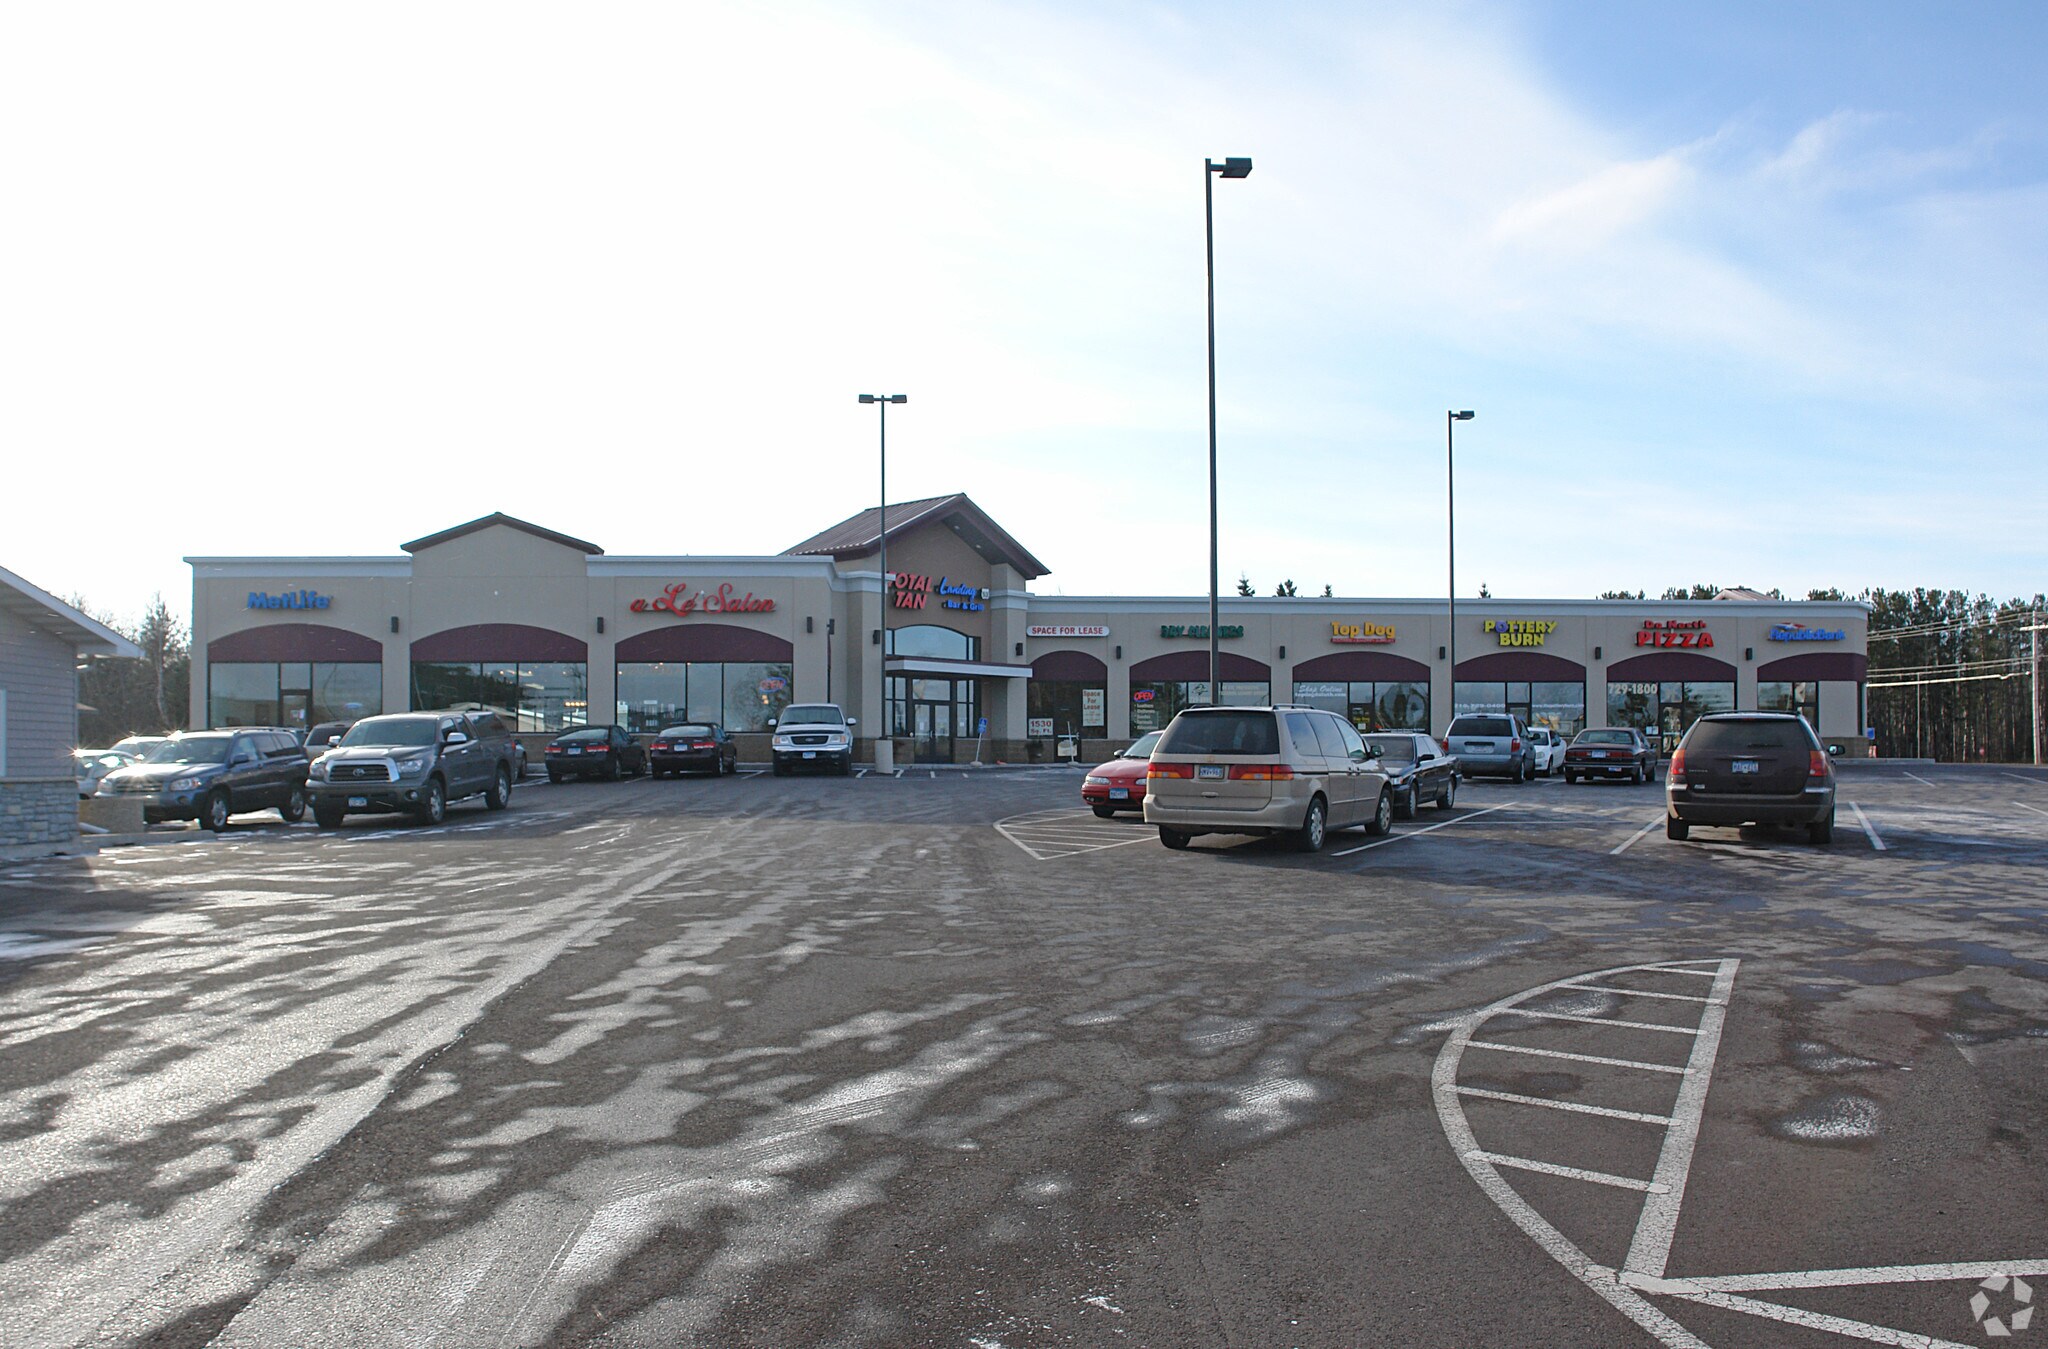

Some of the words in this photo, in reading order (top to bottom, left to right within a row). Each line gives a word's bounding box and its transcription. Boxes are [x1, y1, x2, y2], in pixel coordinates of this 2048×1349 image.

[940, 577, 976, 601] Landing
[247, 589, 330, 609] MetLife
[703, 583, 776, 614] Salon
[895, 591, 927, 609] TAN
[1331, 621, 1359, 638] Top
[1365, 622, 1395, 639] Dog
[1485, 620, 1557, 634] POTTERY
[1500, 633, 1544, 646] BURN
[1638, 631, 1713, 648] PIZZA
[1134, 691, 1153, 700] OPEN
[1608, 684, 1657, 694] 729-1800
